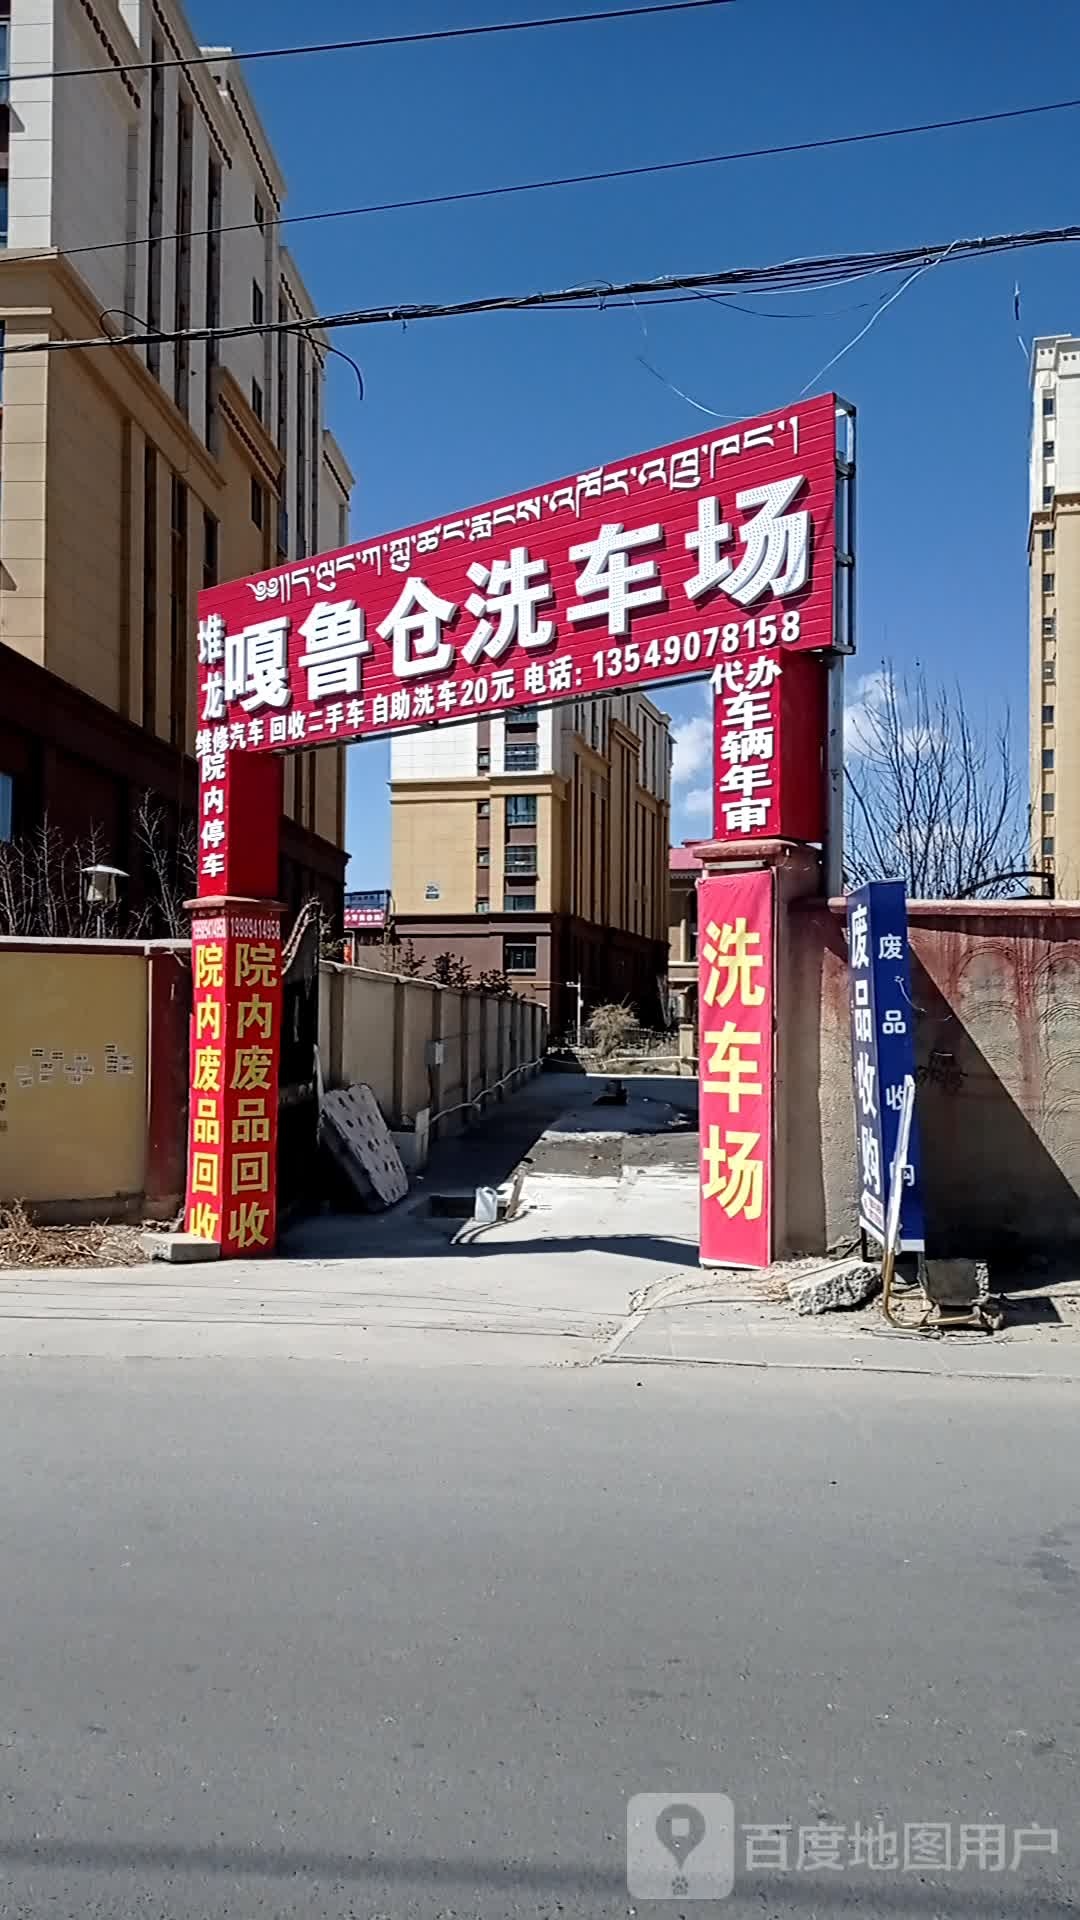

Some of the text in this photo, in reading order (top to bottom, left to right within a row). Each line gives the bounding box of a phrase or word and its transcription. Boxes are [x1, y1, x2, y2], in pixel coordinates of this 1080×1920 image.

[195, 718, 263, 758] 维修汽车
[269, 696, 366, 744] 回收二手车
[372, 668, 515, 726] 自助洗车20元
[592, 610, 800, 679] 13549078158
[197, 613, 227, 721] 堆龙
[225, 475, 809, 712] 嘎鲁仓洗车场
[201, 752, 226, 878] 院内停车
[190, 942, 225, 1243] 院内废品回收
[228, 942, 278, 1248] 院内废品回收
[702, 916, 766, 1221] 洗车场
[850, 903, 882, 1195] 废品收购
